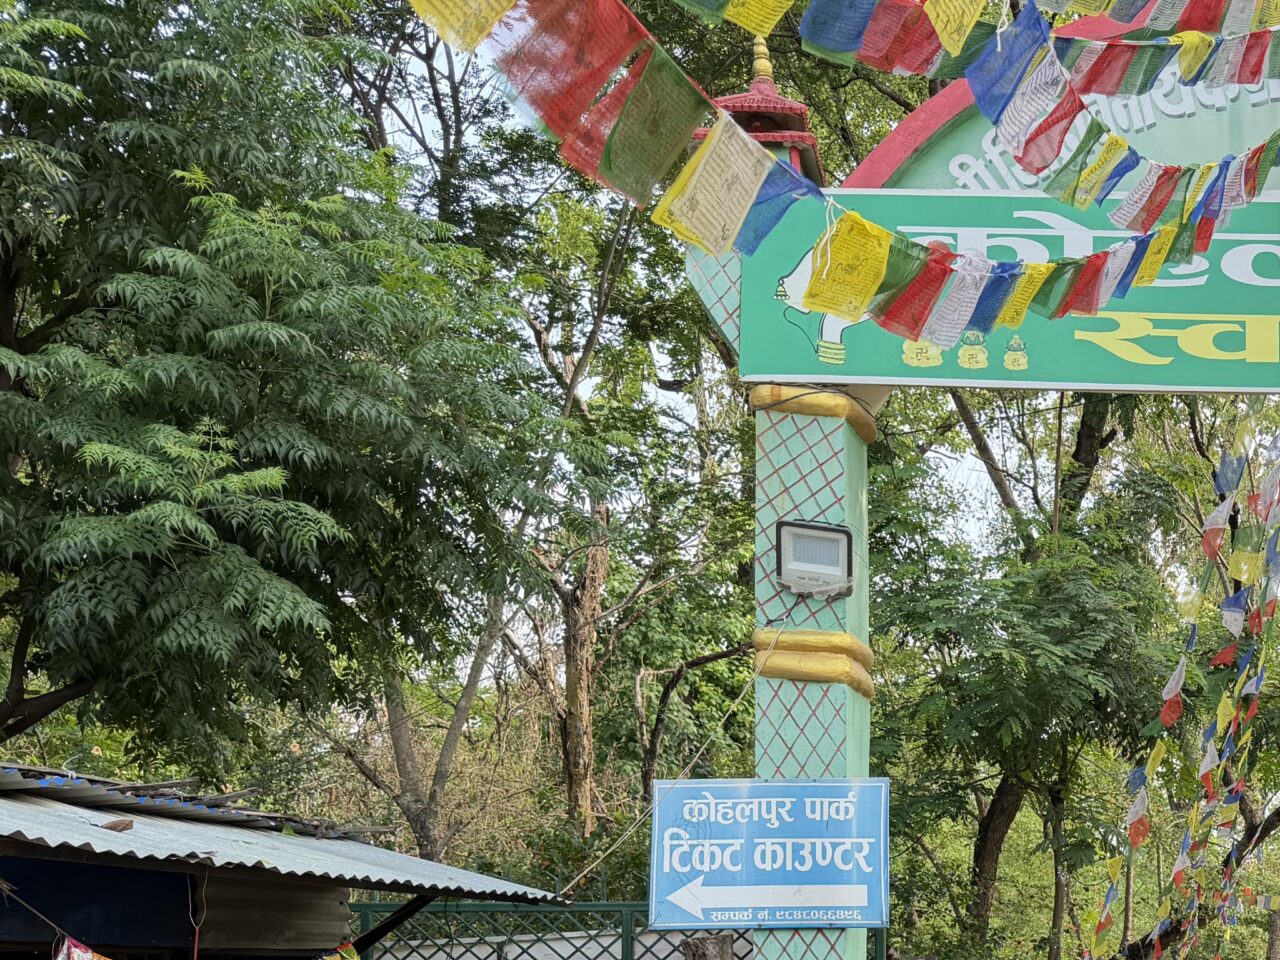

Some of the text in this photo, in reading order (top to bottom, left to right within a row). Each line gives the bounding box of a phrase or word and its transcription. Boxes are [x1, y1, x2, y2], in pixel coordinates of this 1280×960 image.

[683, 791, 857, 828] कोहलपुर पार्क
[662, 827, 876, 873] टिकट काउण्टर
[710, 908, 753, 922] सम्पर्क
